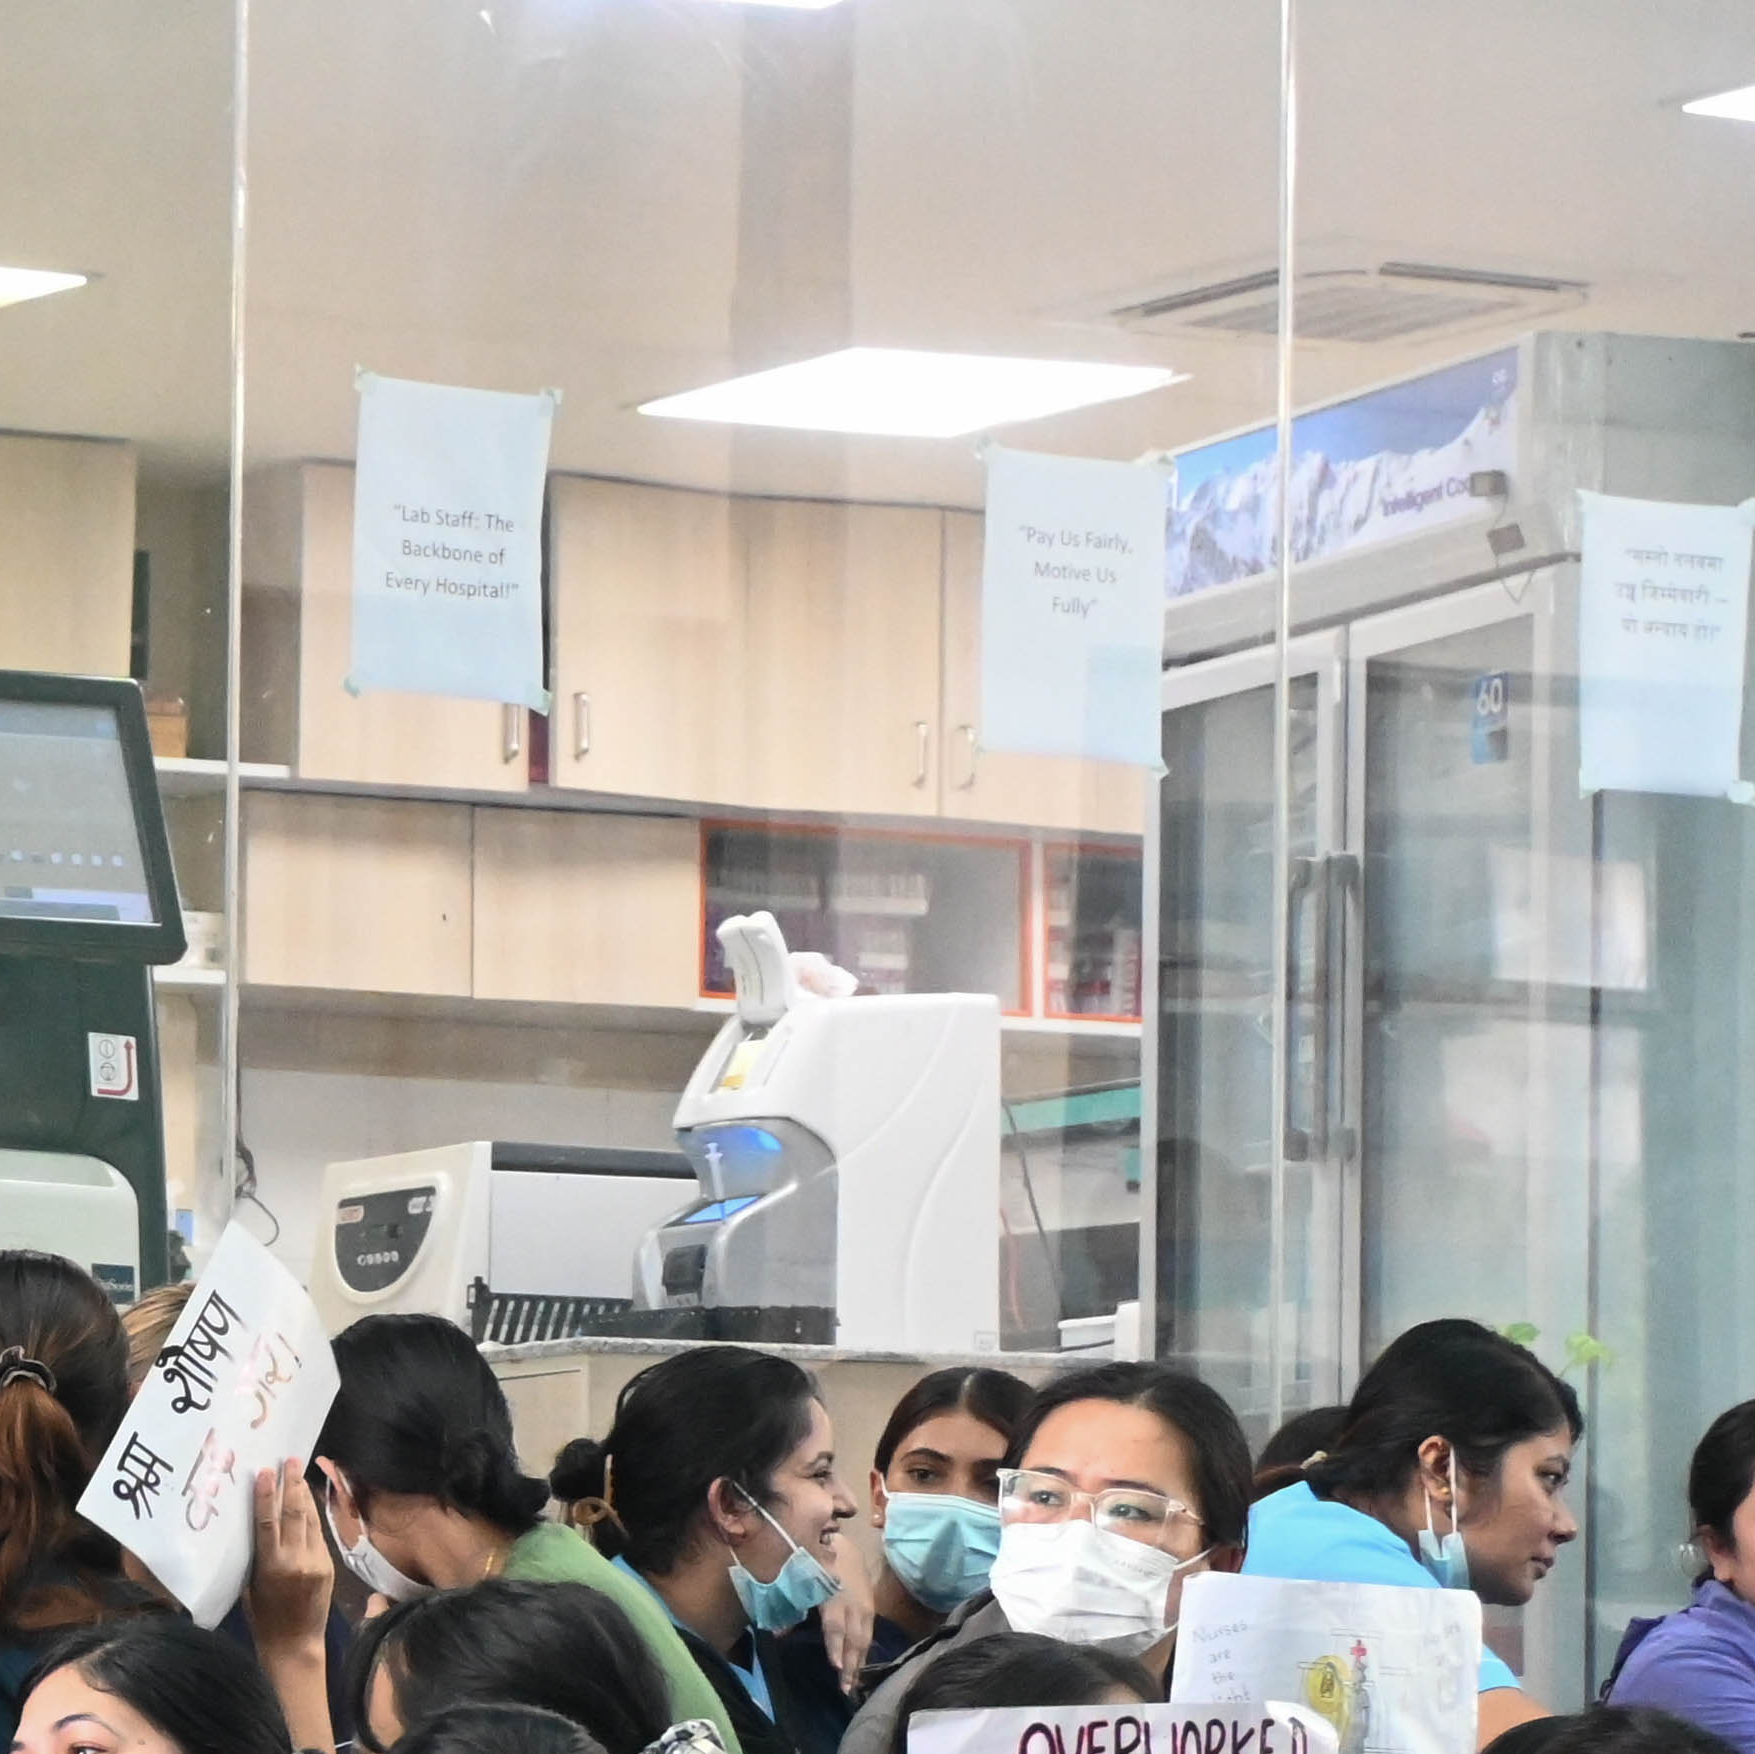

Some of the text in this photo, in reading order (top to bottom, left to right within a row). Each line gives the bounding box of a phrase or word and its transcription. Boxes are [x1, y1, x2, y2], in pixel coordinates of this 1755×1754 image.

[435, 509, 480, 529] Staff:
[484, 513, 514, 532] The
[1060, 529, 1081, 547] Us
[402, 539, 506, 565] Backbone of
[385, 571, 430, 596] Every
[1034, 560, 1117, 583] Motive Us
[1476, 677, 1503, 717] 60
[112, 1288, 249, 1521] श्रम शोषण
